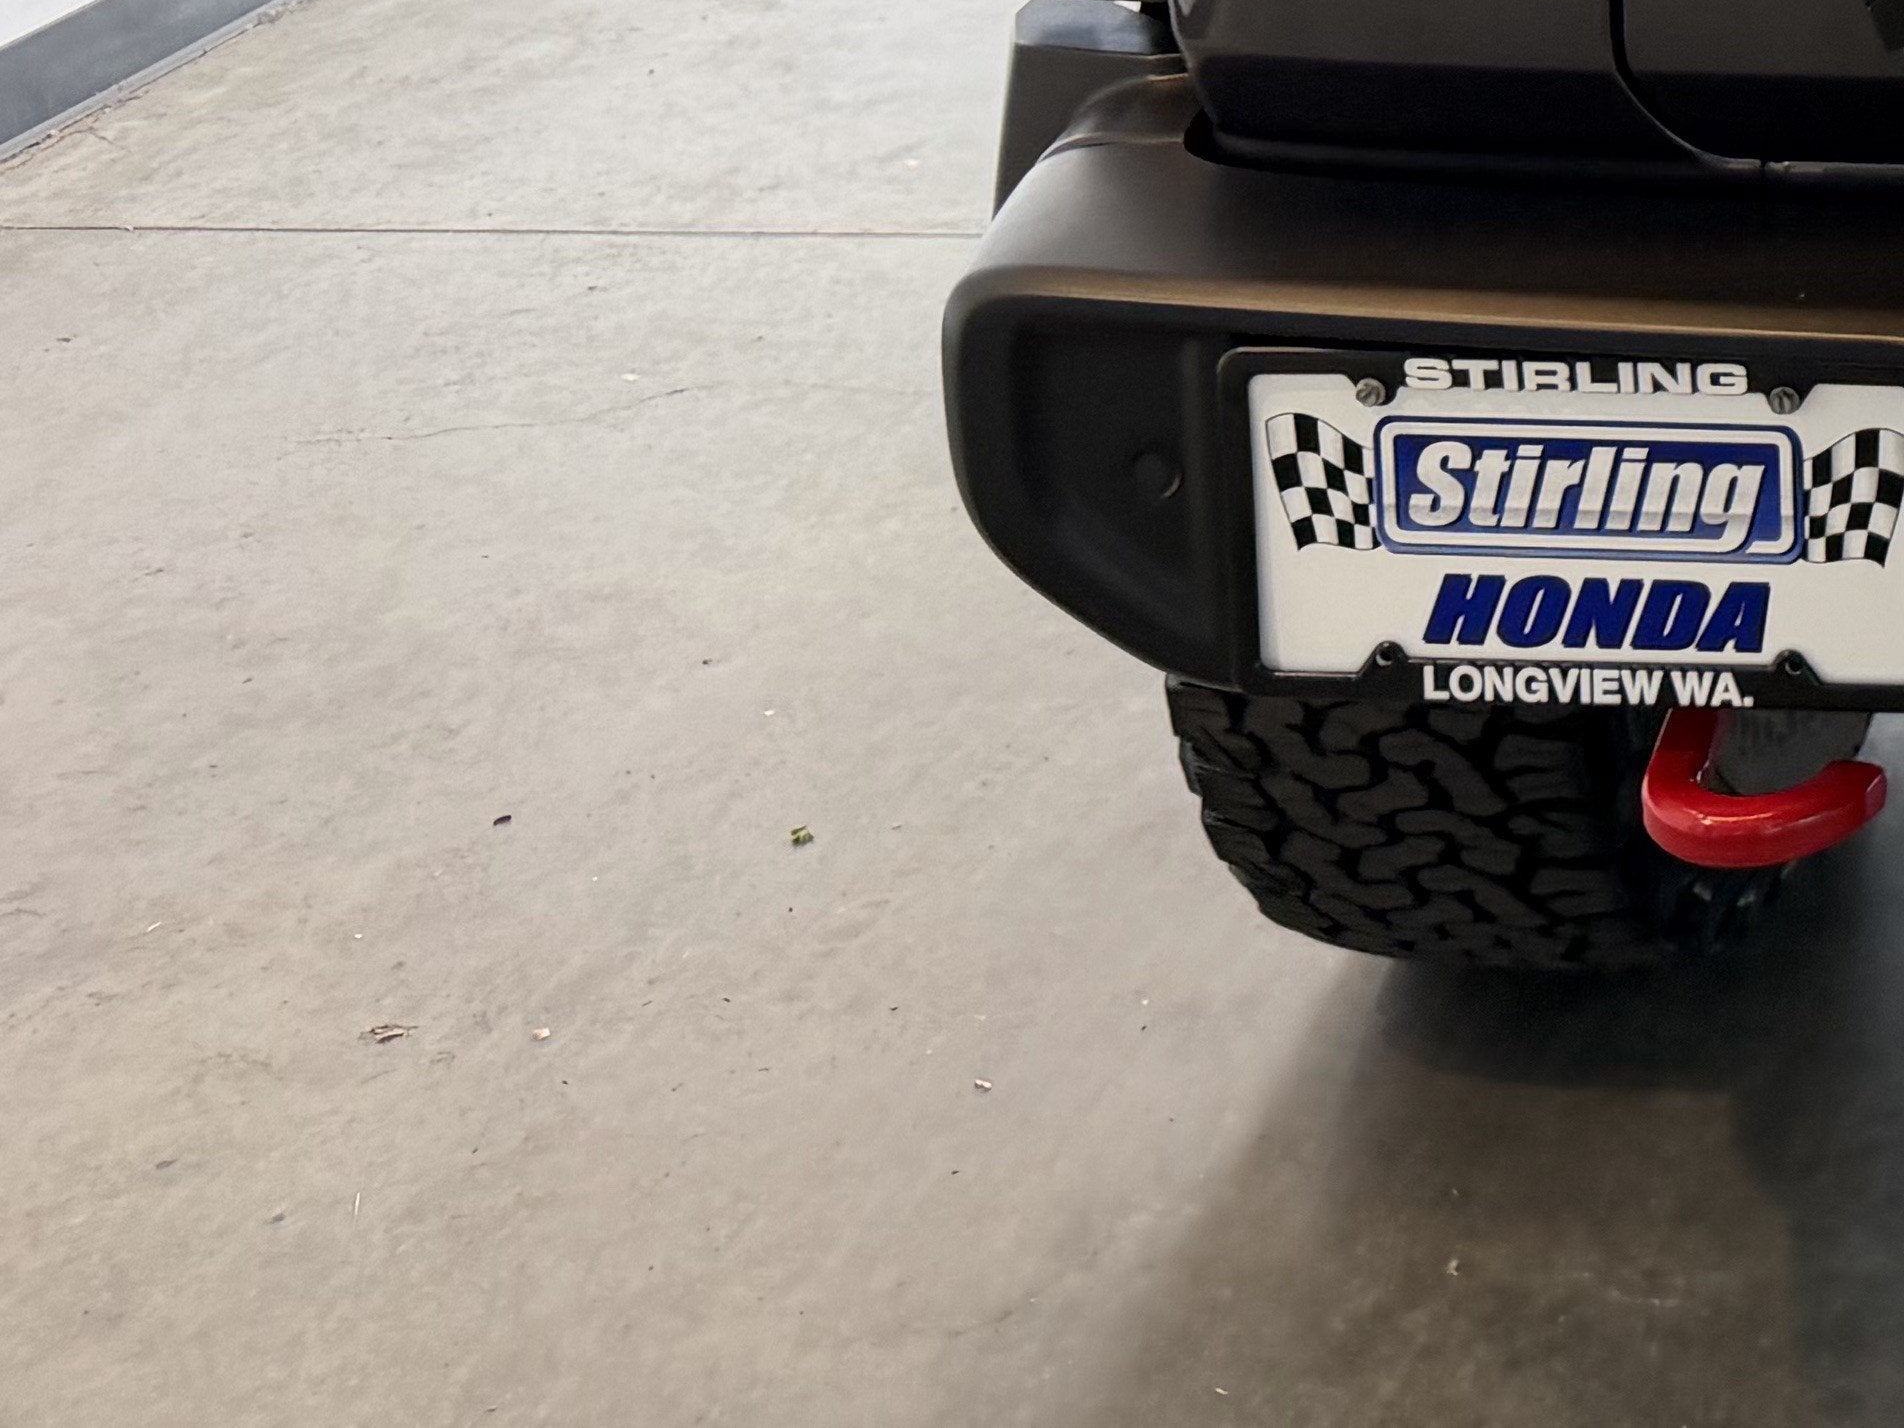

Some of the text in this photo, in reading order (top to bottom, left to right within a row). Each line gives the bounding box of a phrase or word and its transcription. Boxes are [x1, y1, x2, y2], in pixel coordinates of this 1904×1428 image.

[1403, 357, 1749, 396] STIRLING
[1407, 440, 1767, 553] Stirling
[1421, 573, 1772, 654] HONDA
[1422, 664, 1755, 709] LONGVIEW WA.
